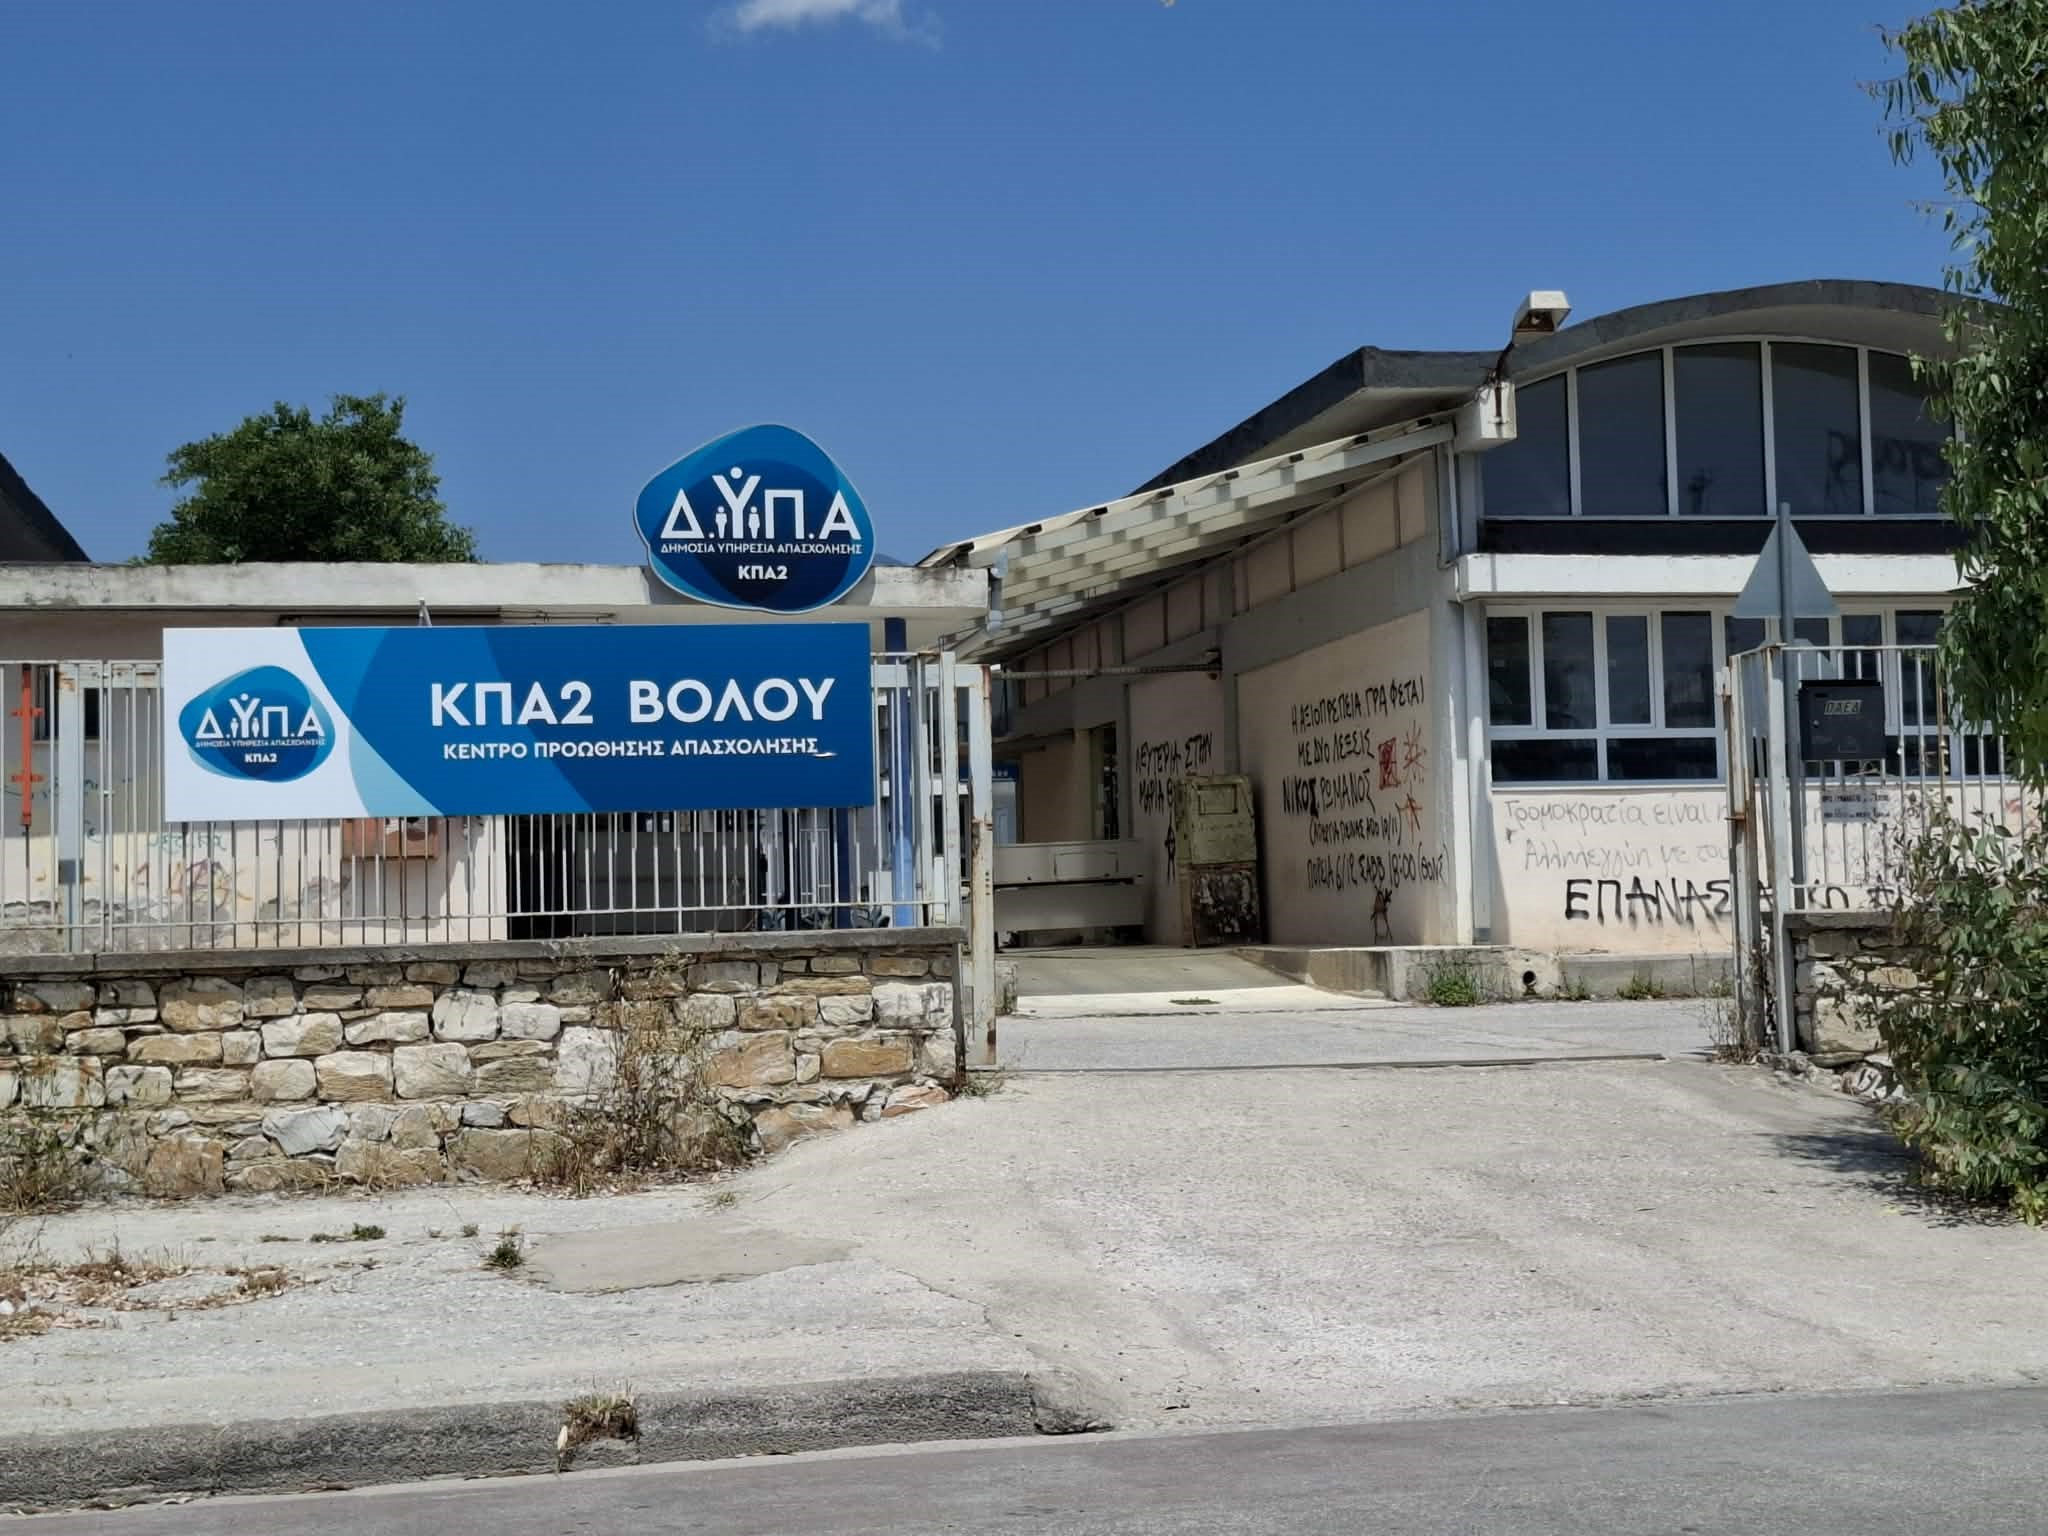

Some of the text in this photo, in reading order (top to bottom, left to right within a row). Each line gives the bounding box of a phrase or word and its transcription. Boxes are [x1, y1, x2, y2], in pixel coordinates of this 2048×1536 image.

[660, 543, 863, 555] ΔΗΜΟΣΙΑ ΥΠΗΡΕΣΙΑ ΑΠΑΣΧΟΛΗΣΗΣ
[738, 565, 788, 580] ΚΠΑ2
[431, 678, 836, 727] ΚΠΑ2 ΒΟΛΟΥ
[444, 738, 818, 760] ΚΕΝΤΡΟ ΠΡΟΩΘΗΣΗΣ ΑΠΑΣΧΟΛΗΣΗΣ
[244, 753, 278, 763] ΚΠΑ2
